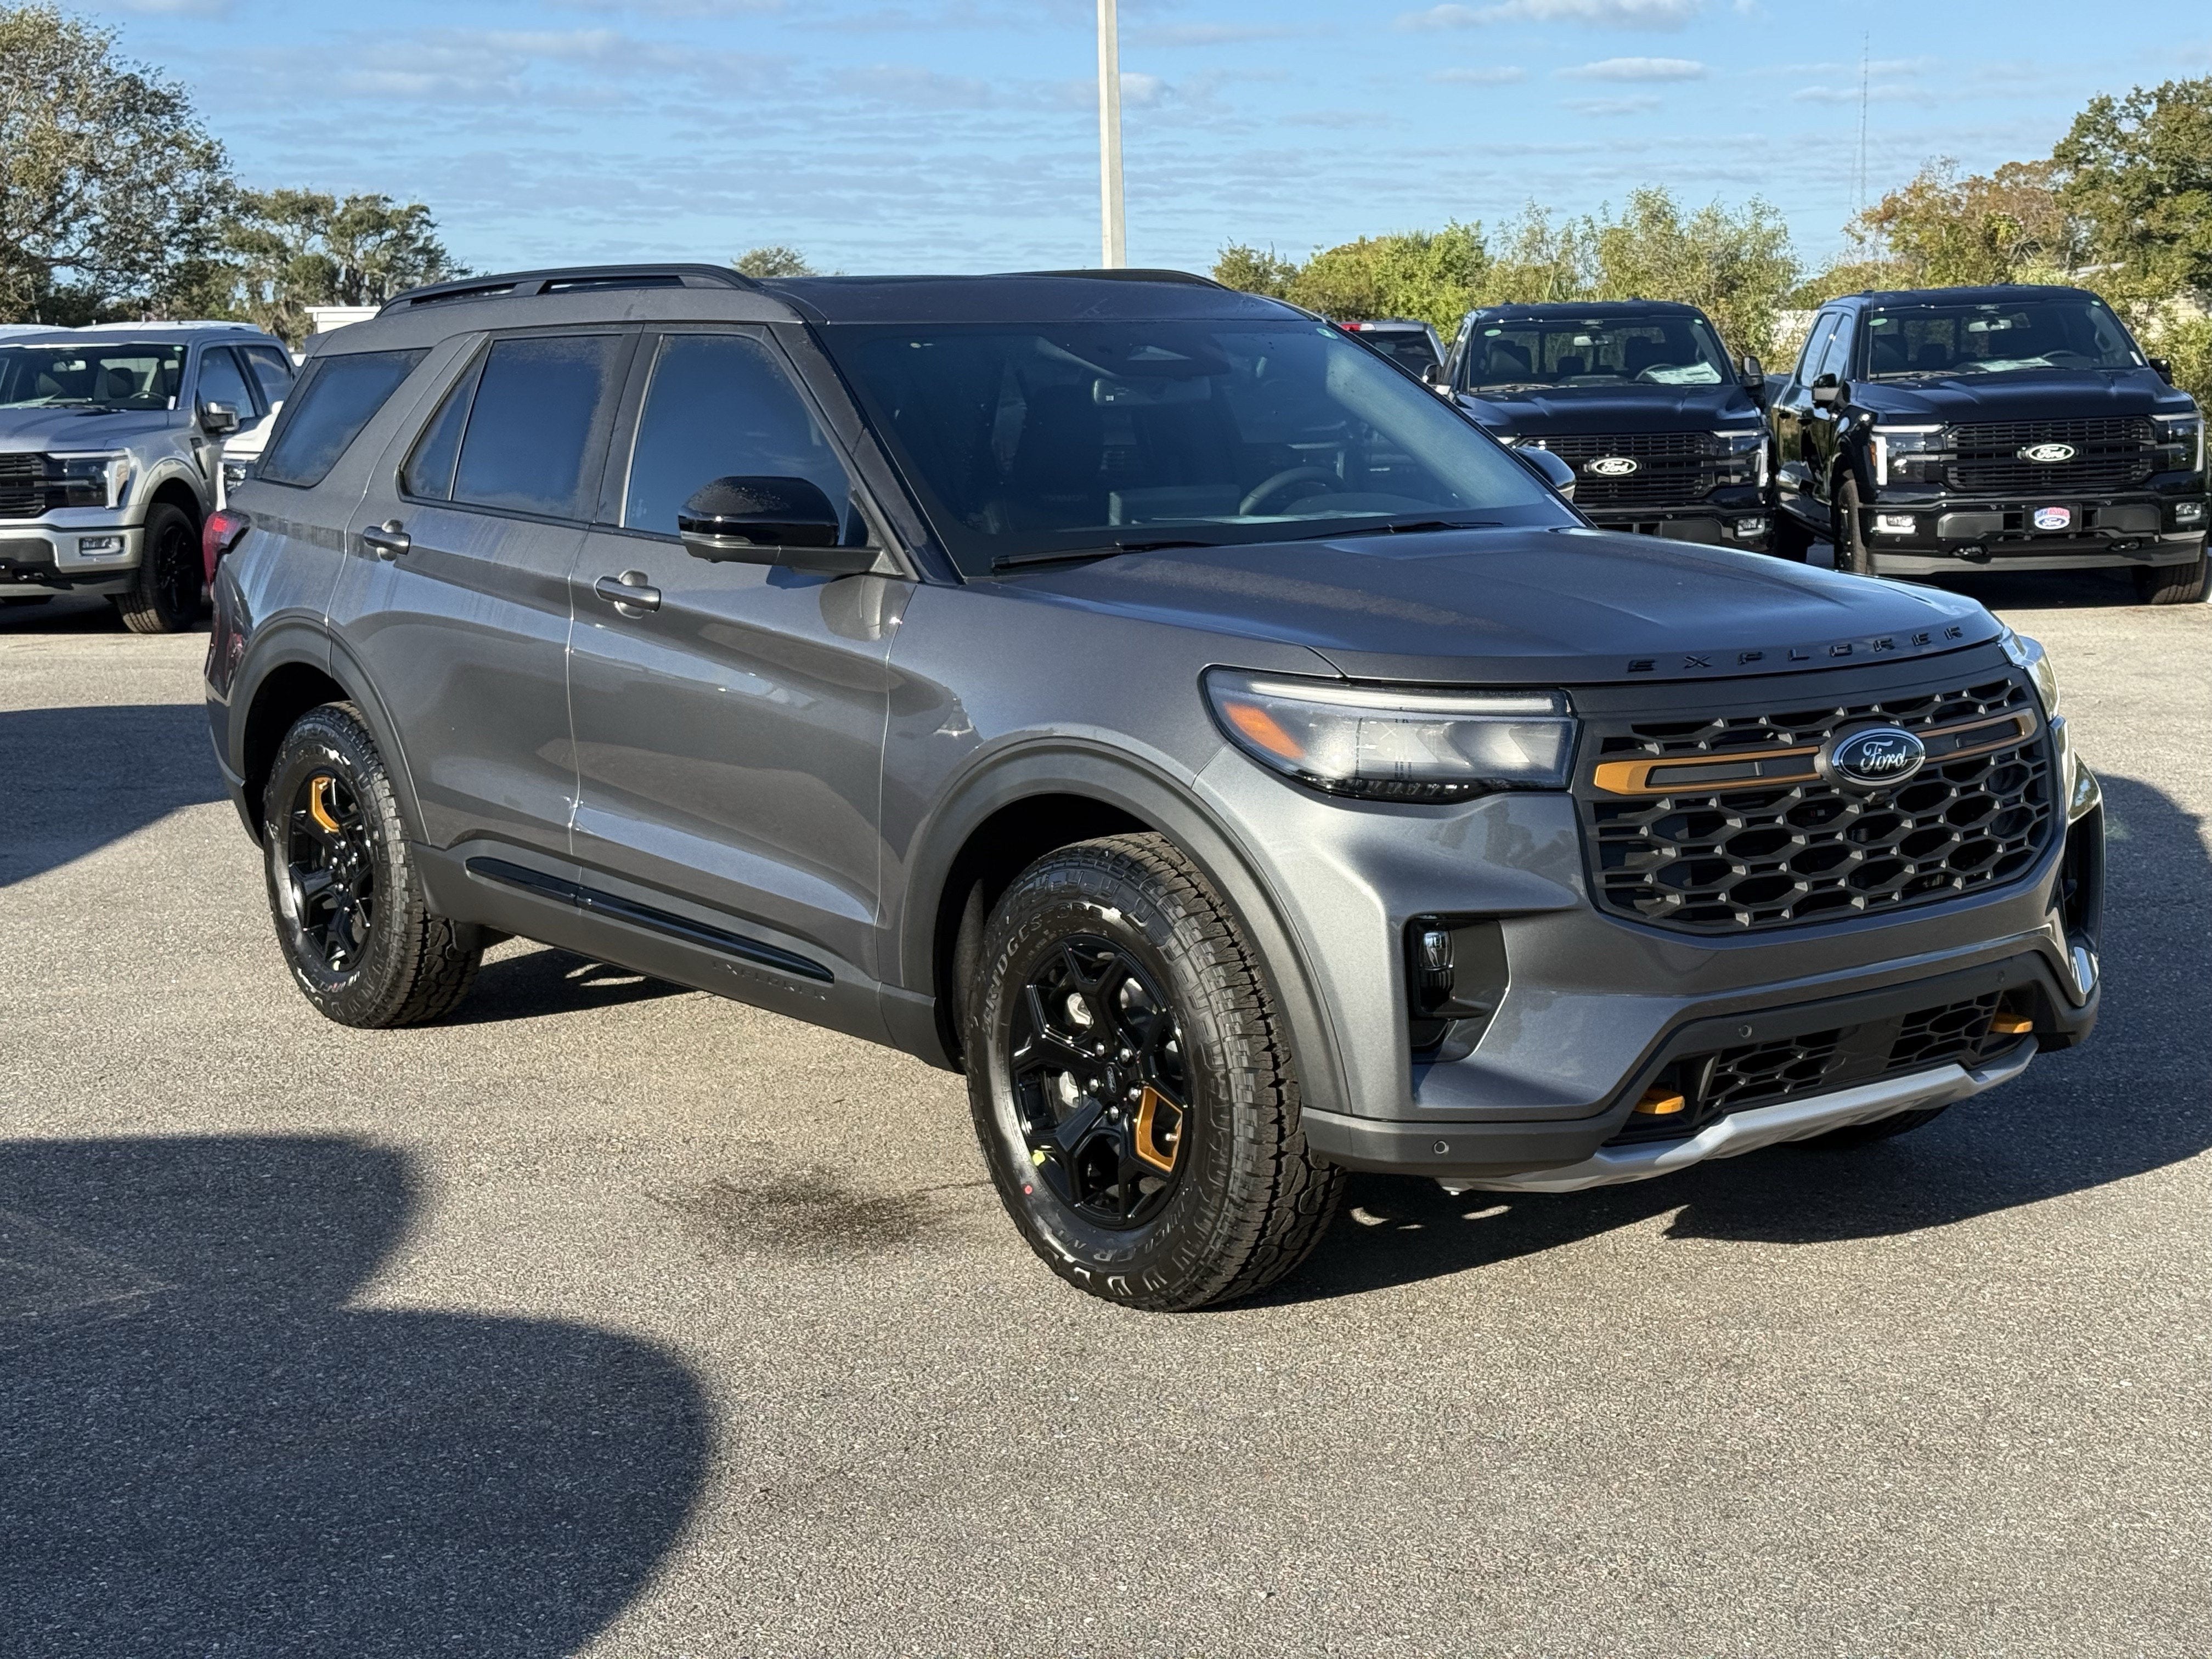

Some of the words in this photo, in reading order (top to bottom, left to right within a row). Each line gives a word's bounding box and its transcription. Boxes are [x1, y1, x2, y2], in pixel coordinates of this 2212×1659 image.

[2037, 447, 2067, 459] Ford
[1601, 461, 1629, 472] Ford
[1627, 625, 1964, 673] EXPLORER
[1860, 740, 1908, 774] Ford
